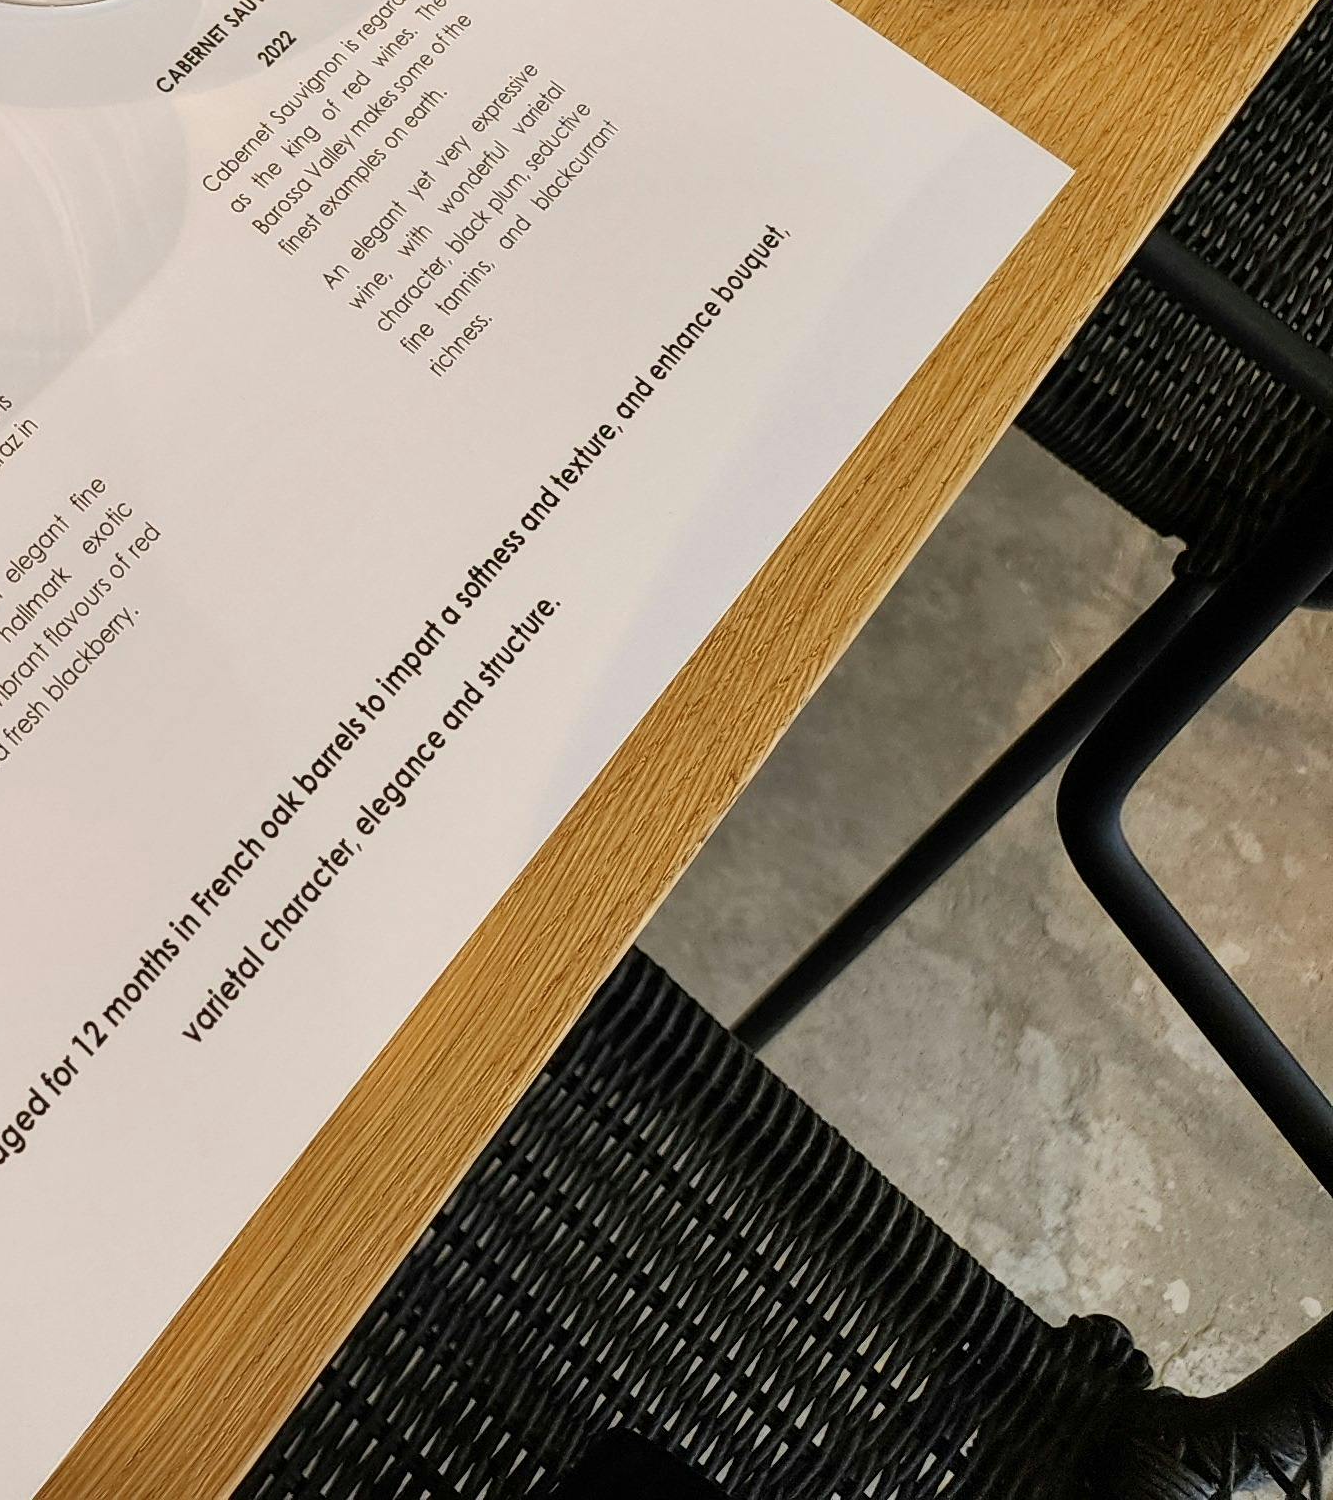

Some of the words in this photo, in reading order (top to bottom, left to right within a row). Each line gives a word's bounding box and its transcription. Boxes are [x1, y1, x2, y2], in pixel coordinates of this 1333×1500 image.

[155, 22, 229, 93] CABERNET
[201, 120, 275, 192] Cabernet
[268, 51, 348, 125] Sauvignon
[338, 38, 360, 54] is
[256, 29, 297, 68] 2022
[39, 1053, 79, 1096] for
[70, 1019, 109, 1057] 12
[101, 937, 180, 1028] months
[167, 913, 202, 942] in
[189, 837, 266, 917] French
[259, 789, 306, 839] oak
[290, 716, 367, 795] barrels
[354, 693, 386, 721] to
[374, 619, 446, 697] impart
[439, 604, 462, 625] a
[454, 529, 526, 609] softness
[519, 483, 561, 532] and
[548, 423, 624, 492] texture,
[615, 374, 655, 420] and
[648, 300, 722, 380] enhance
[709, 223, 791, 304] bouquet,
[180, 944, 265, 1042] varietal
[259, 836, 363, 952] character,
[355, 730, 446, 835] elegance
[441, 679, 485, 731] and
[477, 598, 561, 688] structure.
